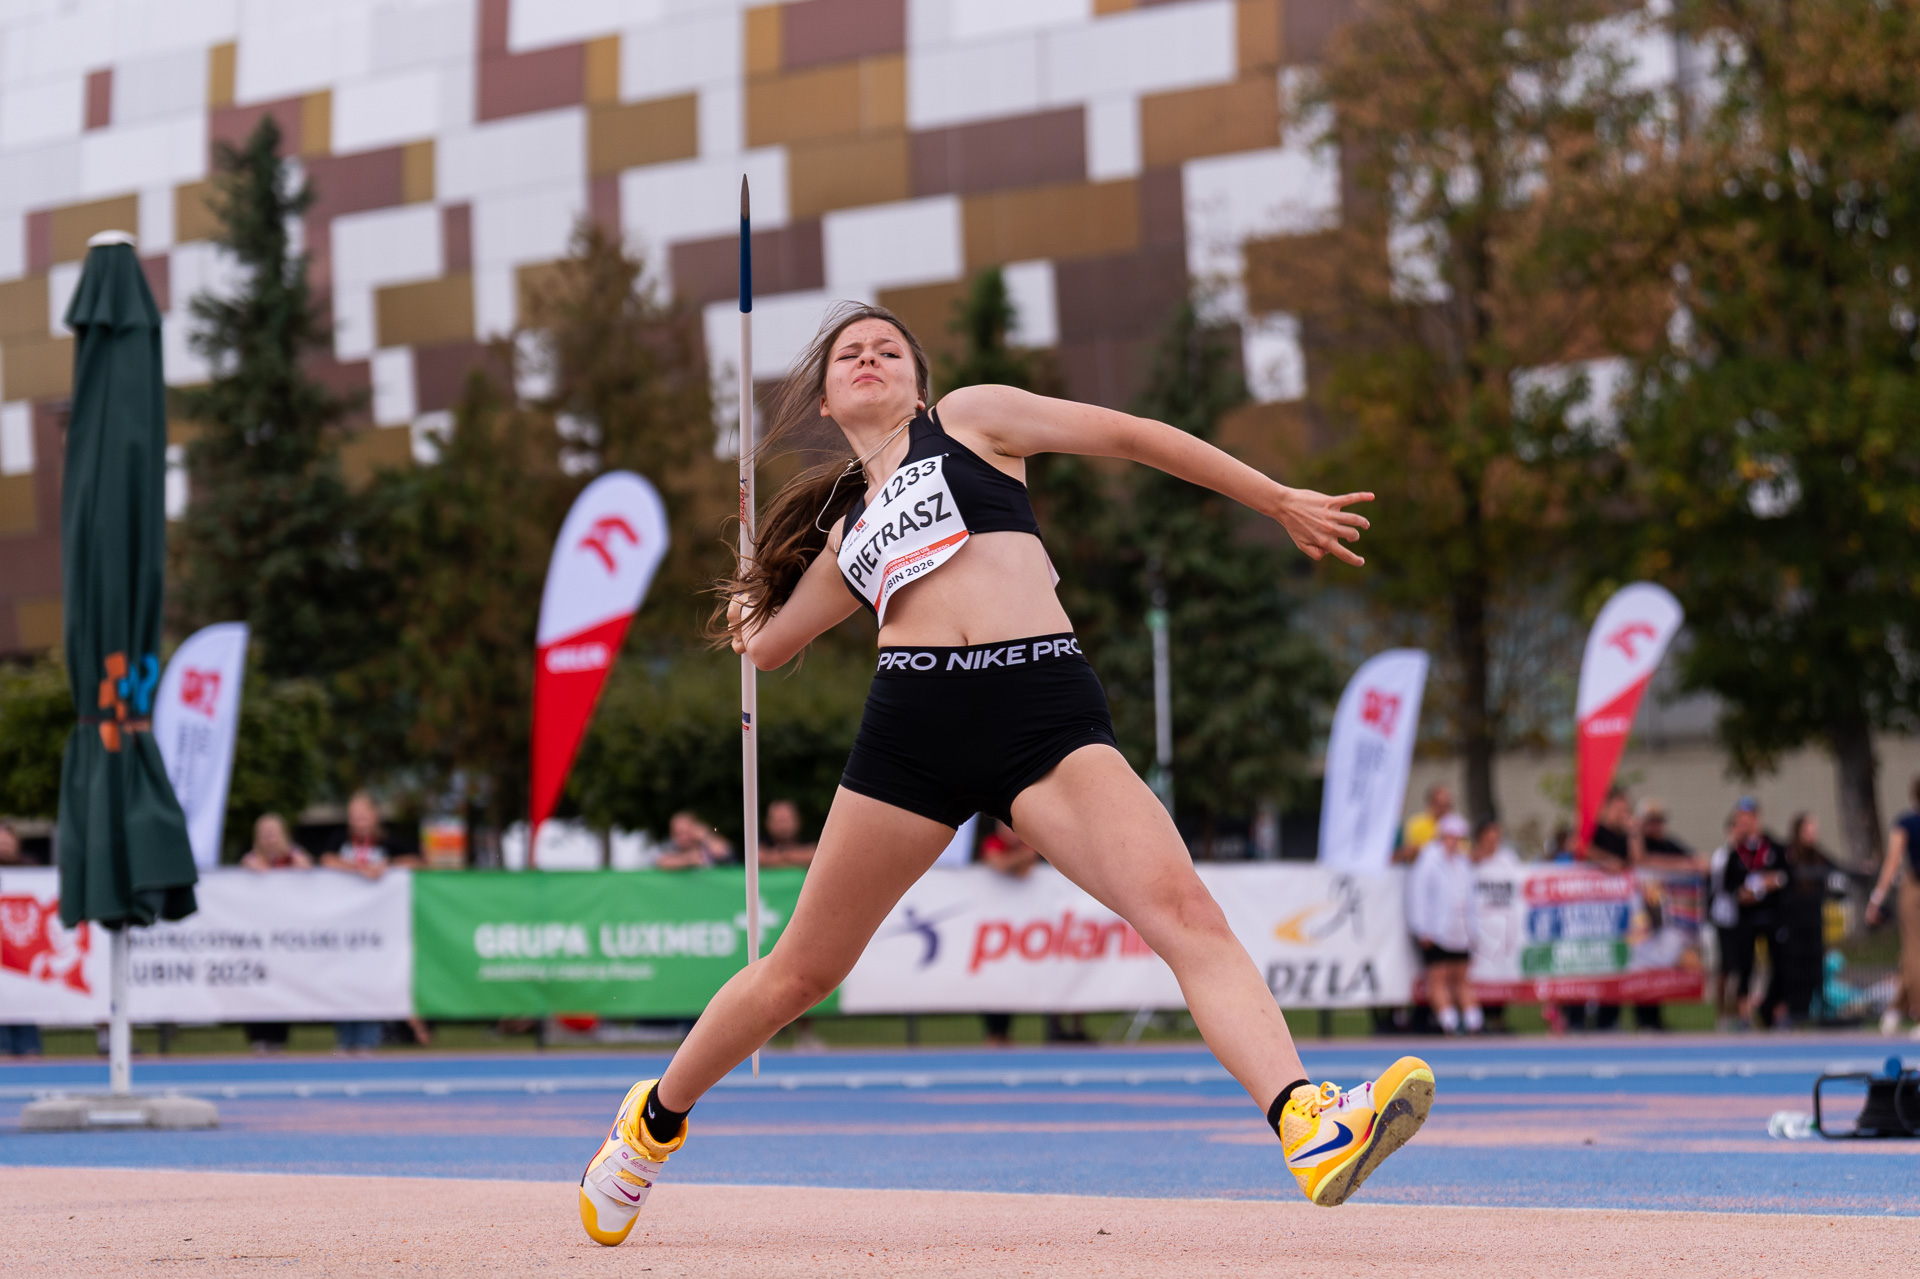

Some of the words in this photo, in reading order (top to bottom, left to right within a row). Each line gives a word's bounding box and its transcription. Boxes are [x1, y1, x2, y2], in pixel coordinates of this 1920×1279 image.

[881, 461, 936, 507] 1233
[848, 491, 952, 589] PIETRASZ
[905, 559, 934, 577] 2026
[877, 652, 937, 671] PRO
[946, 644, 1026, 671] NIKE
[475, 922, 590, 959] GRUPA
[600, 921, 737, 958] LUXMED
